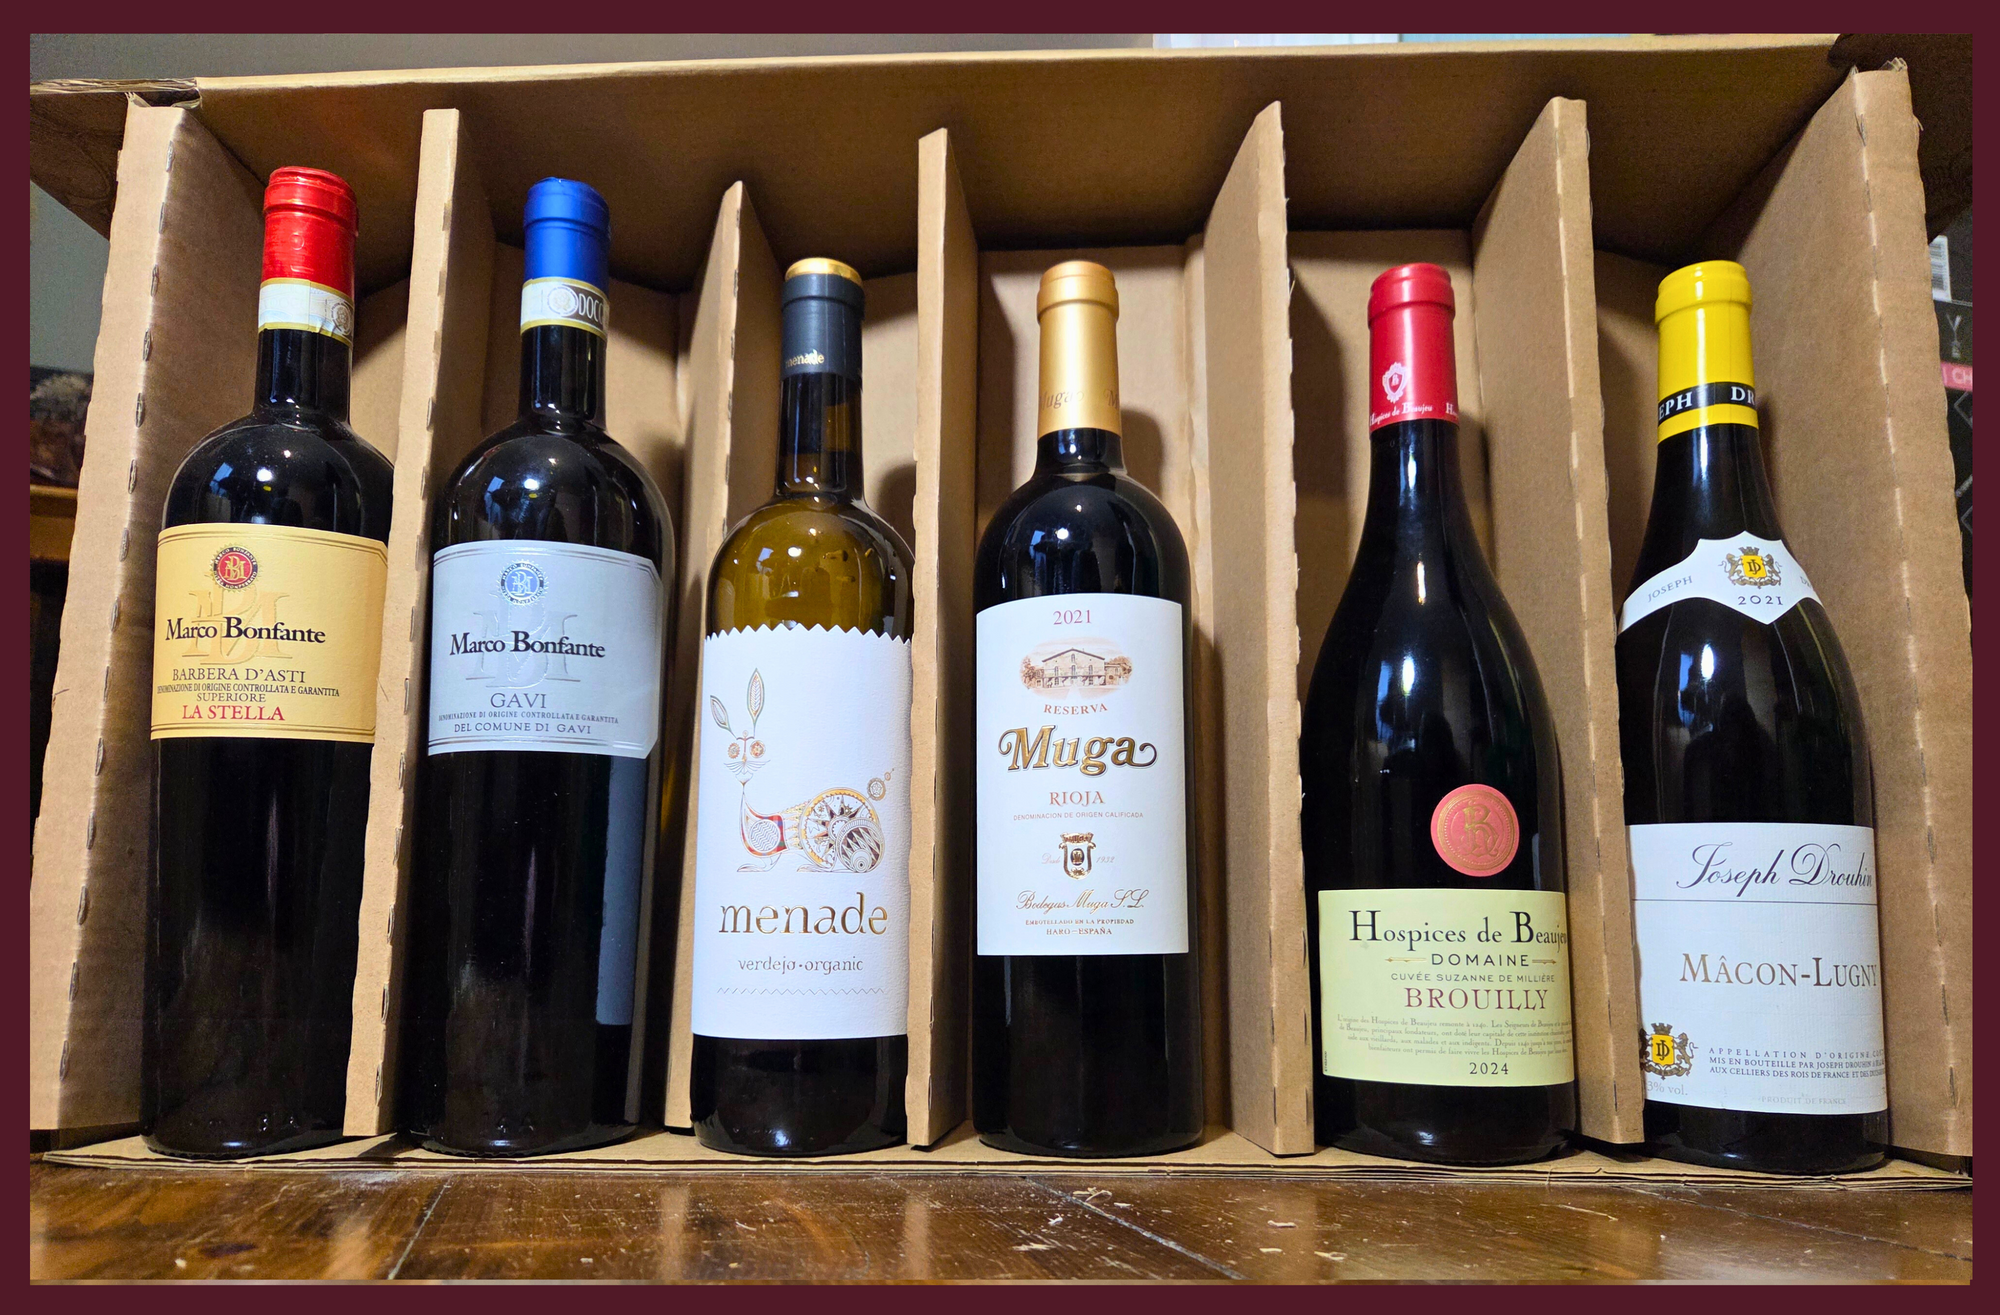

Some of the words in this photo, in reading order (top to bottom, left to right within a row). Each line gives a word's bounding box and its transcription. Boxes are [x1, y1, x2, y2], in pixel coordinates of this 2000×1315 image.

[785, 349, 825, 369] menade
[1391, 406, 1401, 417] de
[1402, 401, 1433, 415] Beaujeu
[1647, 575, 1693, 603] JOSEPH
[1737, 595, 1784, 605] 2021
[1052, 609, 1093, 625] 2021
[165, 618, 218, 641] Marco
[221, 616, 326, 643] Bonfante
[450, 632, 506, 656] Marco
[510, 630, 606, 658] Bonfante
[172, 667, 240, 682] BARBERA
[193, 683, 201, 691] DI
[201, 683, 231, 692] ORIGINE
[232, 683, 290, 693] CONTROLLATA
[290, 686, 297, 694] E
[297, 686, 340, 697] GARANTITA
[196, 692, 267, 702] SUPERIORE
[490, 692, 547, 709] GAVI
[182, 705, 202, 719] LA
[207, 705, 285, 721] STELLA
[1043, 702, 1109, 716] RESERVA
[520, 711, 575, 720] CONTROLLATA
[581, 714, 619, 724] GARANTITA
[454, 723, 472, 732] DEL
[475, 722, 531, 731] COMUNE
[535, 722, 549, 732] DI
[556, 723, 591, 734] GAVI
[998, 725, 1158, 776] Muga
[1049, 790, 1106, 807] RIOJA
[1013, 812, 1062, 821] DENOMINACION
[1105, 811, 1144, 819] CALIFICADA
[1676, 841, 1785, 898] Joseph
[1788, 843, 1873, 888] Drouhin
[1016, 889, 1067, 915] Bodegas
[1067, 889, 1109, 915] Muga
[718, 891, 888, 935] menade
[1348, 910, 1467, 952] Hospices
[1477, 916, 1503, 943] de
[1431, 953, 1530, 967] DOMAINE
[1391, 971, 1431, 982] CUVÉE
[1437, 974, 1494, 983] SUZANNE
[1498, 974, 1513, 982] DE
[1517, 973, 1556, 983] MILLIÈRE
[1679, 952, 1878, 988] MÂCON-LUGNY
[1404, 987, 1549, 1011] BROUILLY
[1371, 1016, 1399, 1027] Hospices
[1410, 1018, 1437, 1028] Beaujeu
[1414, 1036, 1439, 1044] malades
[1482, 1029, 1505, 1039] capitale
[1438, 1046, 1446, 1054] de
[1709, 1047, 1807, 1059] APPELLATION
[1469, 1062, 1509, 1075] 2024
[1744, 1058, 1796, 1068] BOUTEILLE
[1816, 1062, 1844, 1070] JOSEPH
[1709, 1066, 1728, 1074] AUX
[1729, 1067, 1771, 1077] CELLIERS
[1772, 1069, 1789, 1077] DES
[1790, 1070, 1810, 1078] ROIS
[1811, 1071, 1822, 1079] DE
[1823, 1070, 1850, 1079] FRANCE
[1851, 1070, 1859, 1079] ET
[1667, 1084, 1688, 1096] vol.
[1761, 1096, 1801, 1104] PRODUIT
[1805, 1096, 1815, 1104] DE
[1818, 1097, 1847, 1105] FRANCE
